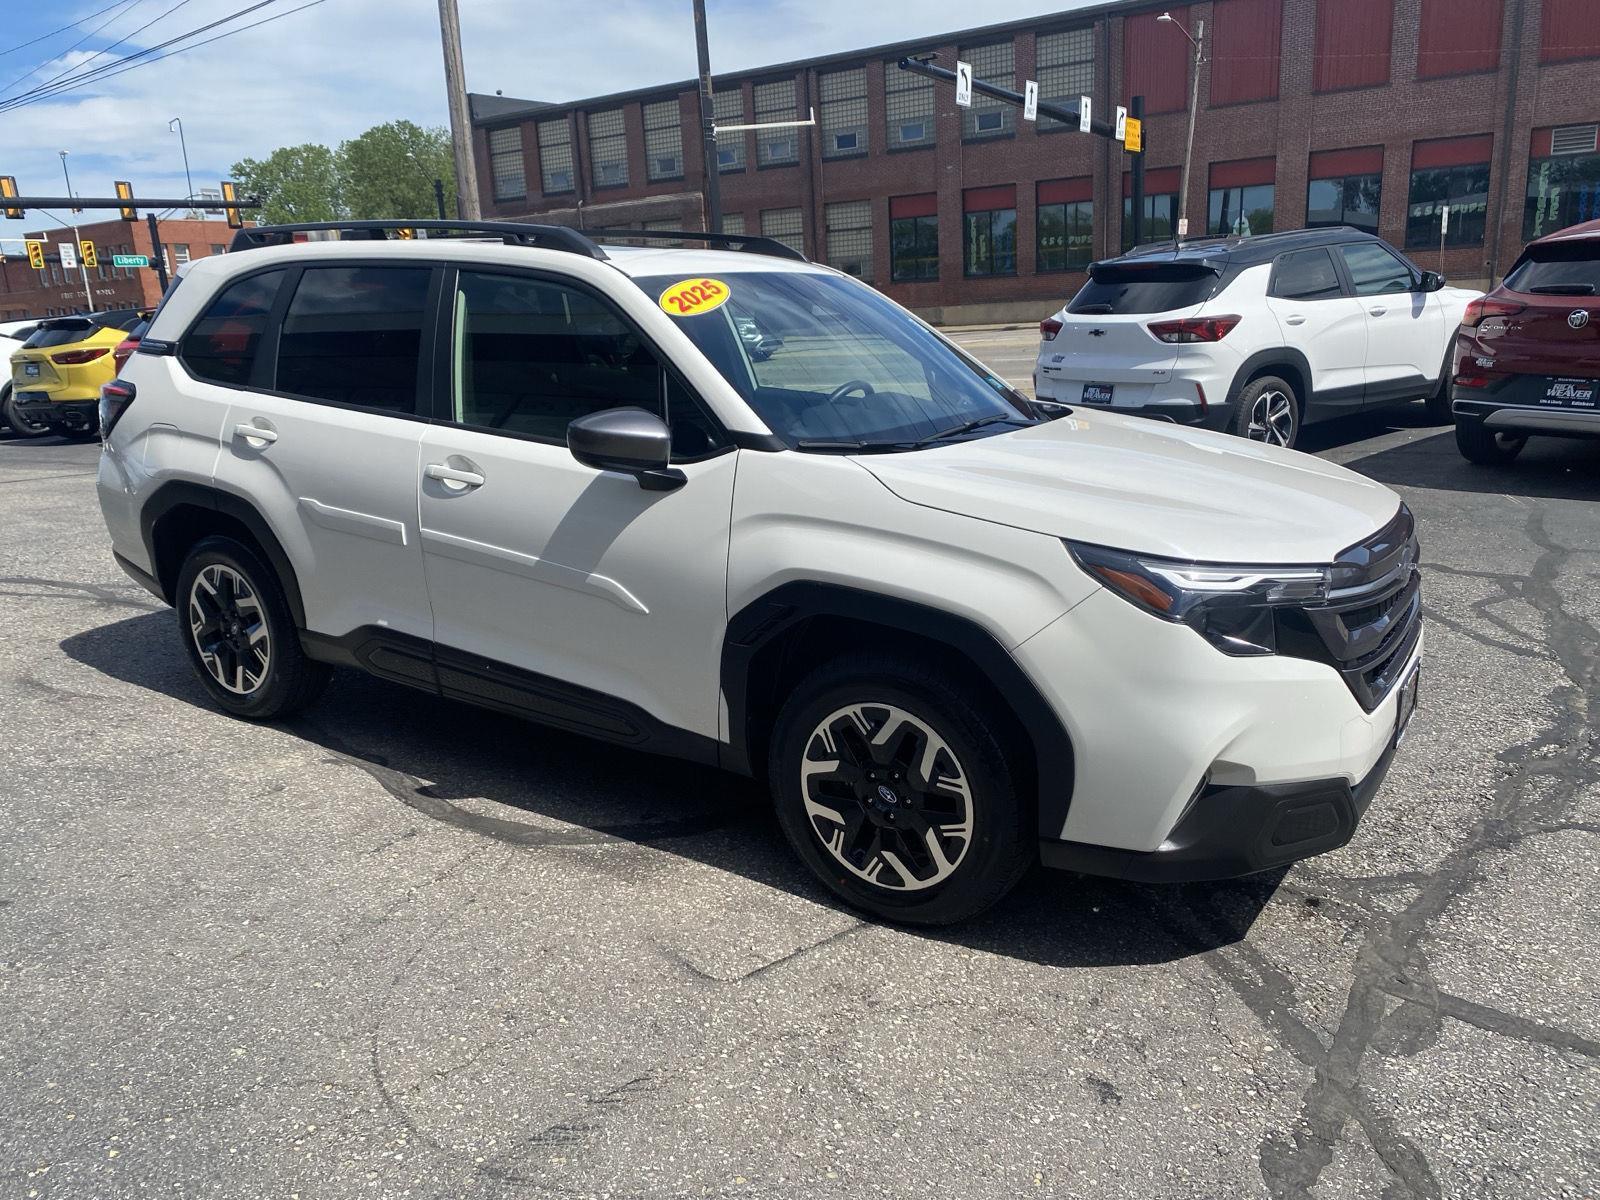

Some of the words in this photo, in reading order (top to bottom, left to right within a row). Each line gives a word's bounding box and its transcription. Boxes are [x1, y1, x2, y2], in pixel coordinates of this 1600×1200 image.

[117, 257, 144, 265] Liberty
[669, 280, 722, 312] 2025
[1553, 383, 1575, 391] RICK
[1547, 388, 1593, 398] WEAVER
